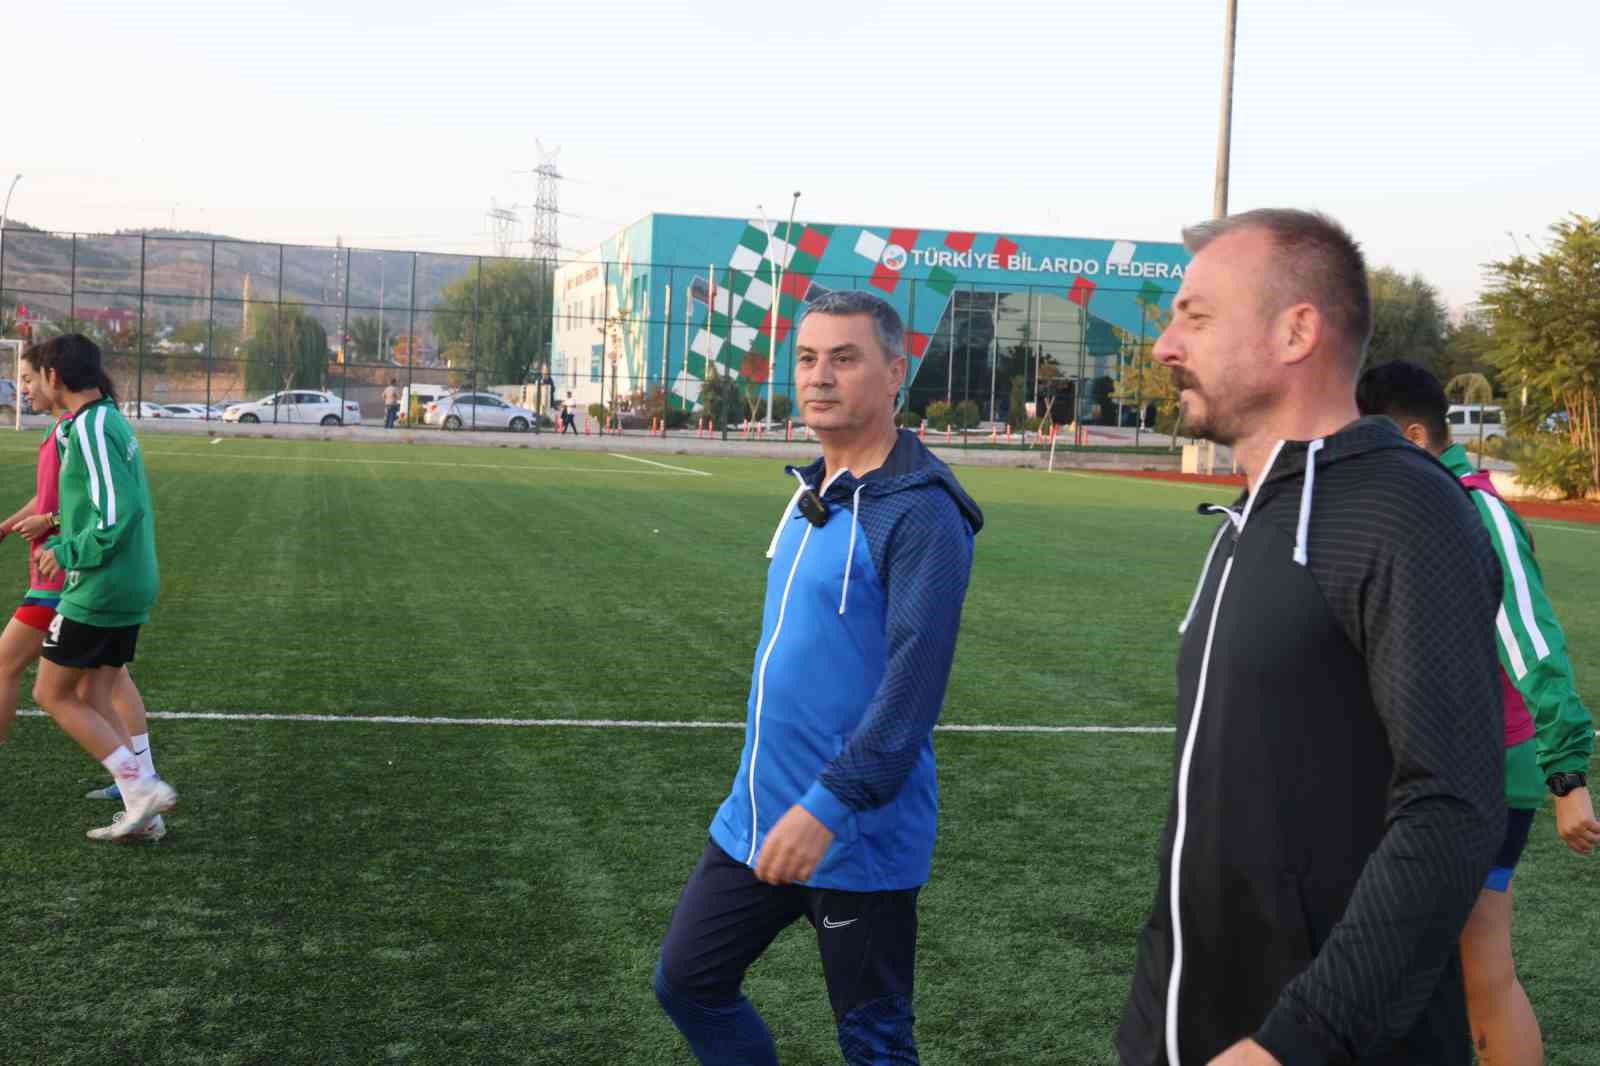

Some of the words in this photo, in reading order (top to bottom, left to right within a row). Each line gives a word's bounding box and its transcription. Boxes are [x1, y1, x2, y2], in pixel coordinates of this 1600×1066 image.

[911, 247, 1000, 270] TÜRKİYE
[1007, 252, 1099, 275] BİLARDO
[1105, 257, 1190, 279] FEDERA
